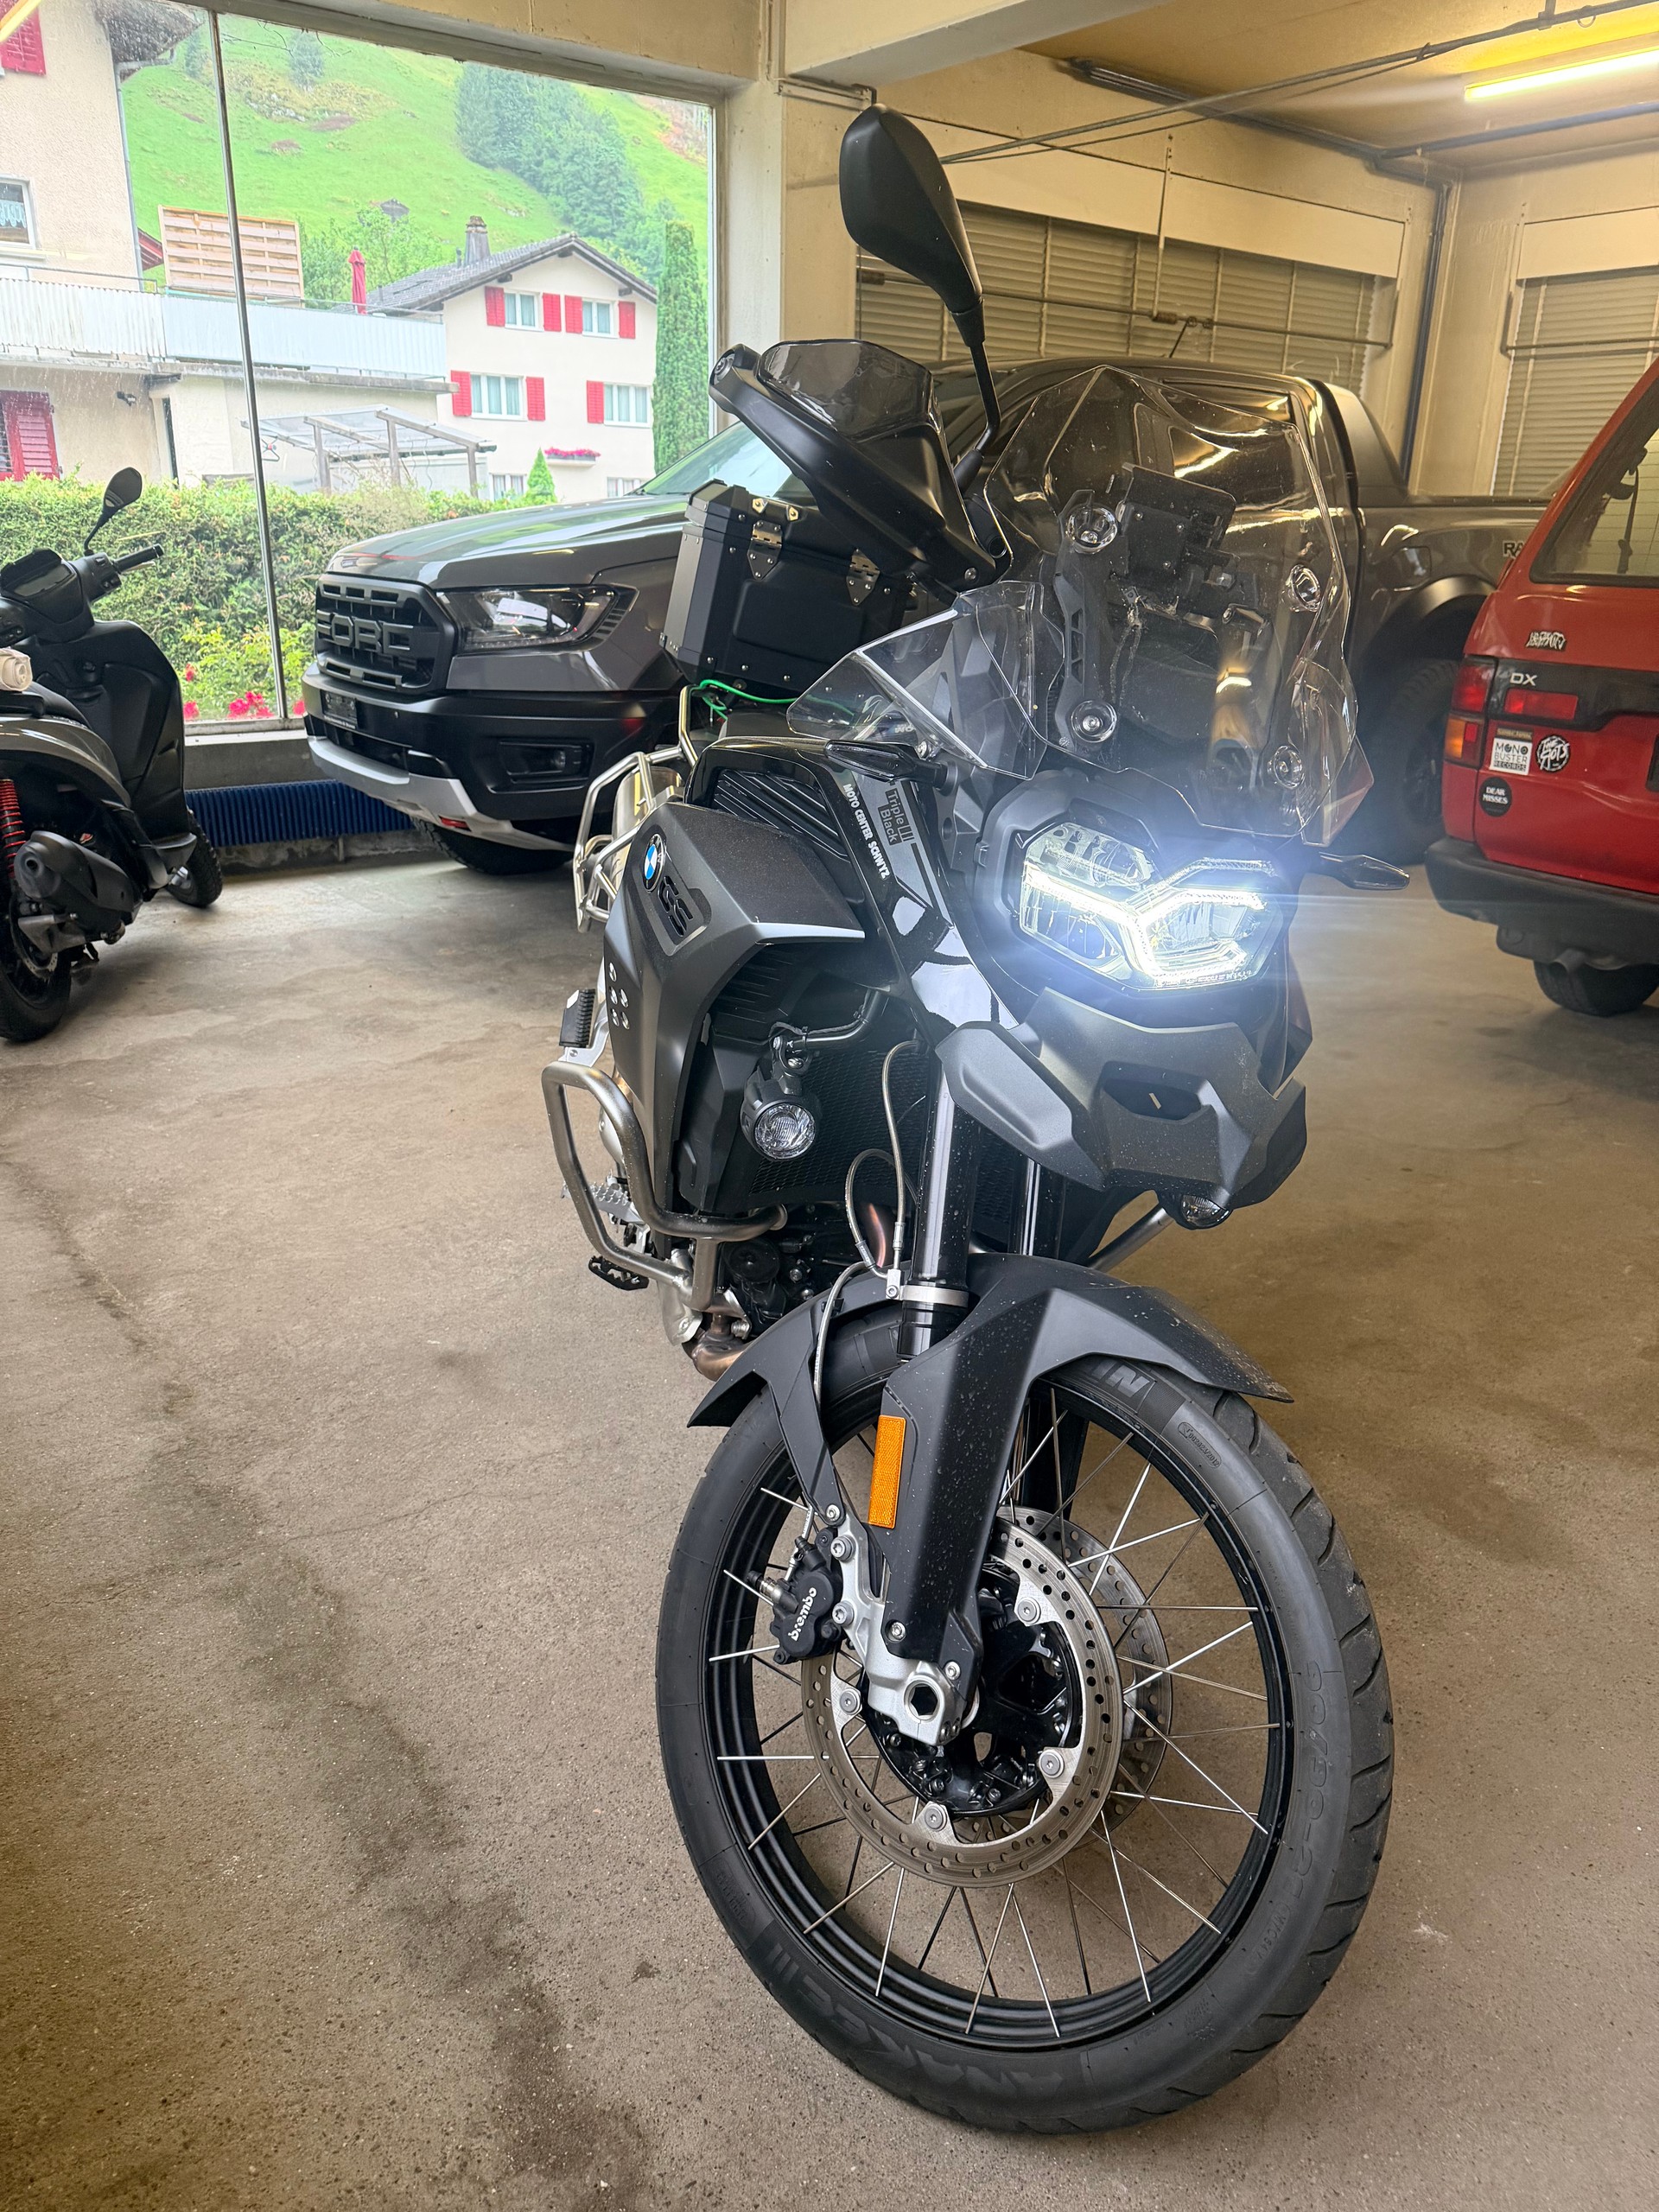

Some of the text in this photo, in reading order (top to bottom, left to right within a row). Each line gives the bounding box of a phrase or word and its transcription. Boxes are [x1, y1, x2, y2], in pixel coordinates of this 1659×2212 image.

[1510, 672, 1537, 686] DX
[1495, 741, 1529, 755] MONO
[1494, 752, 1528, 765] BUSTER
[1493, 760, 1527, 772] RECORDS
[1486, 786, 1505, 796] DEAR
[1483, 793, 1509, 804] MISSES
[887, 790, 905, 825] Triple
[842, 783, 891, 880] MOTO CENTER SCHWYZ
[880, 809, 898, 843] Black
[788, 1587, 817, 1641] brembo
